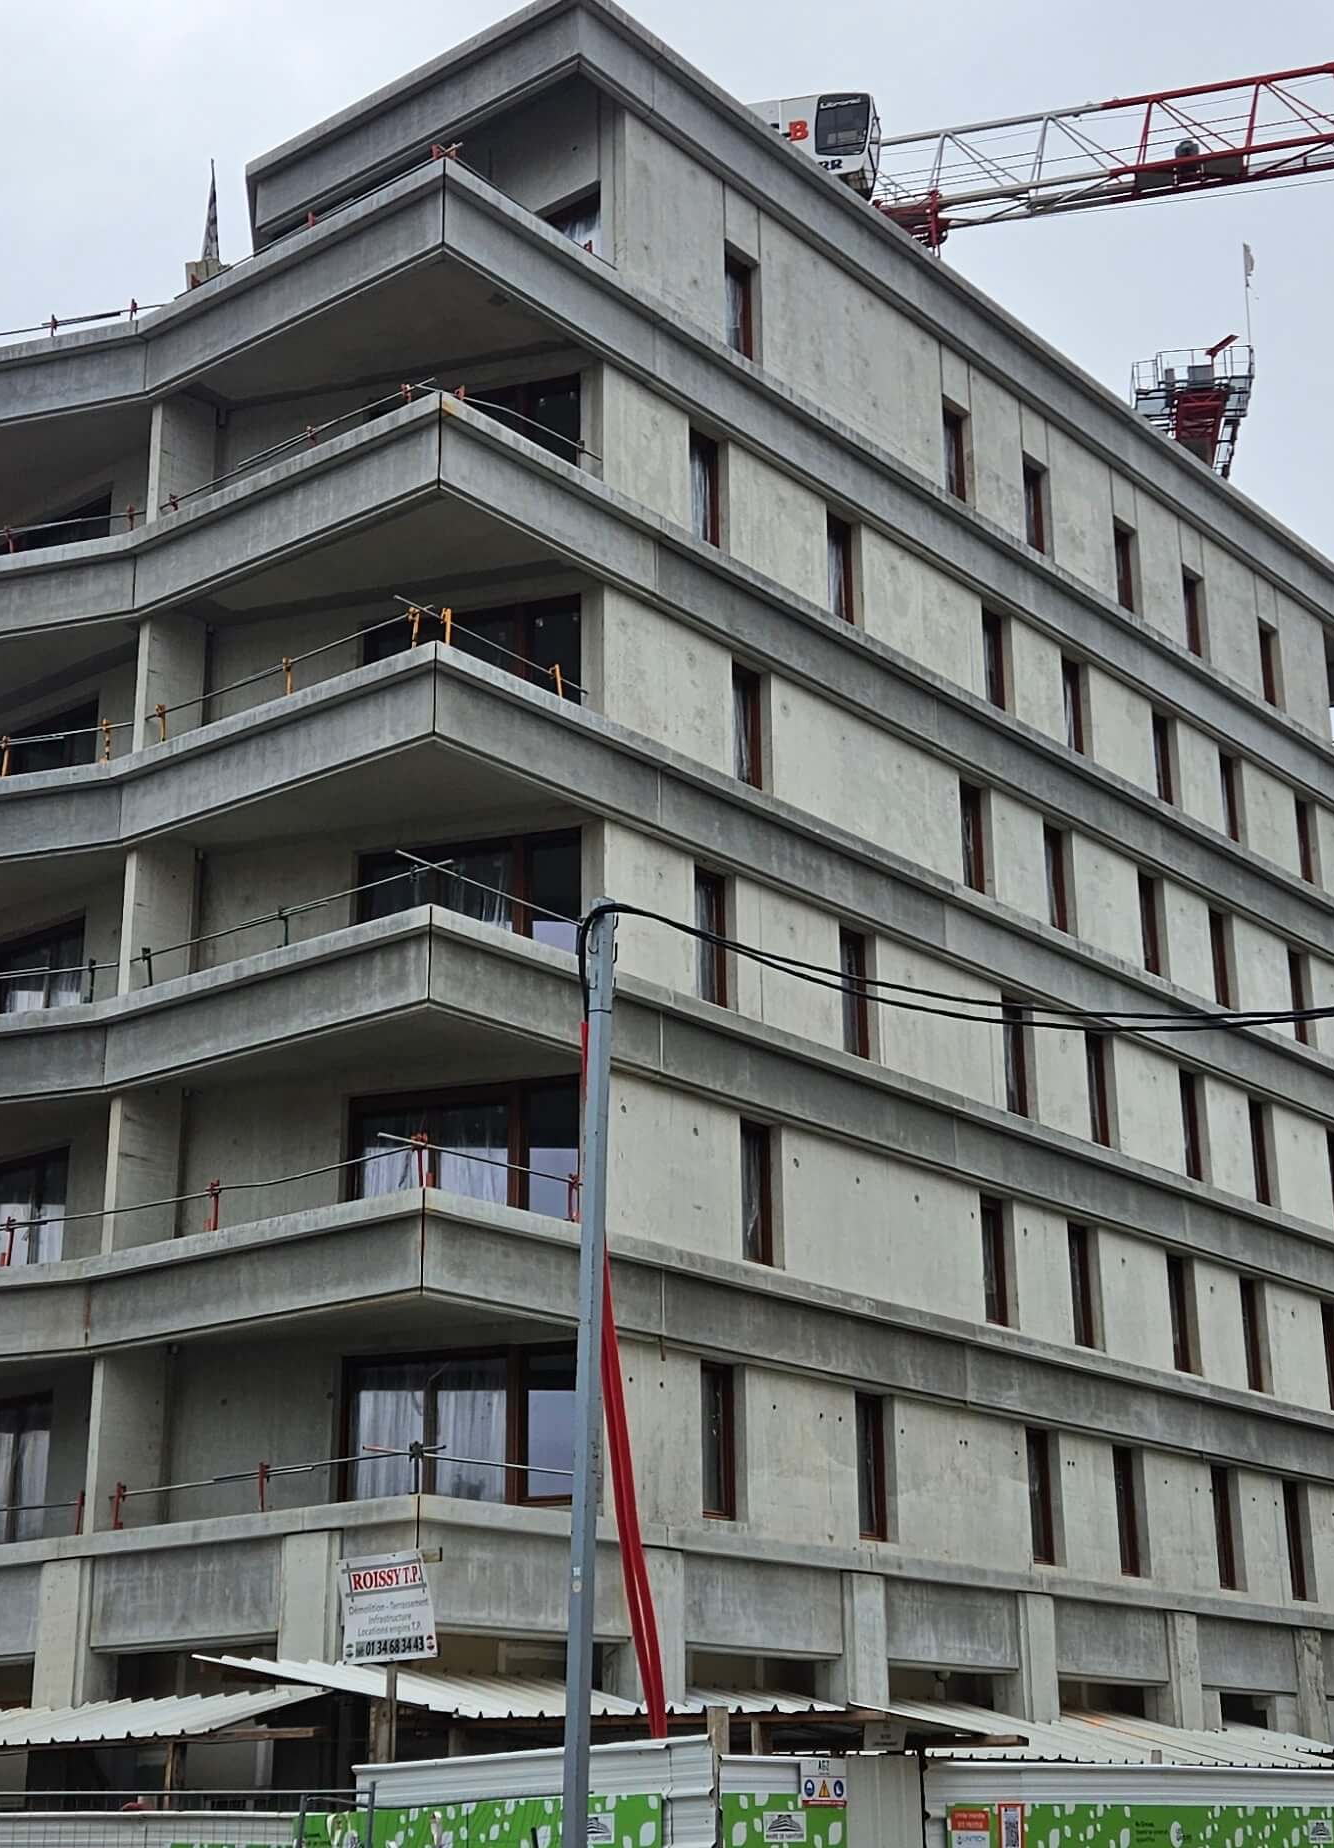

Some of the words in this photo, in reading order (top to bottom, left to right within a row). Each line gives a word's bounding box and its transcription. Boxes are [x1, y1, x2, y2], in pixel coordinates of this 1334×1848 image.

[352, 1568, 402, 1591] ROISSY
[404, 1566, 422, 1584] T.P.
[365, 1641, 375, 1656] 01
[377, 1640, 388, 1655] 34
[401, 1638, 412, 1653] 34
[414, 1637, 425, 1651] 43
